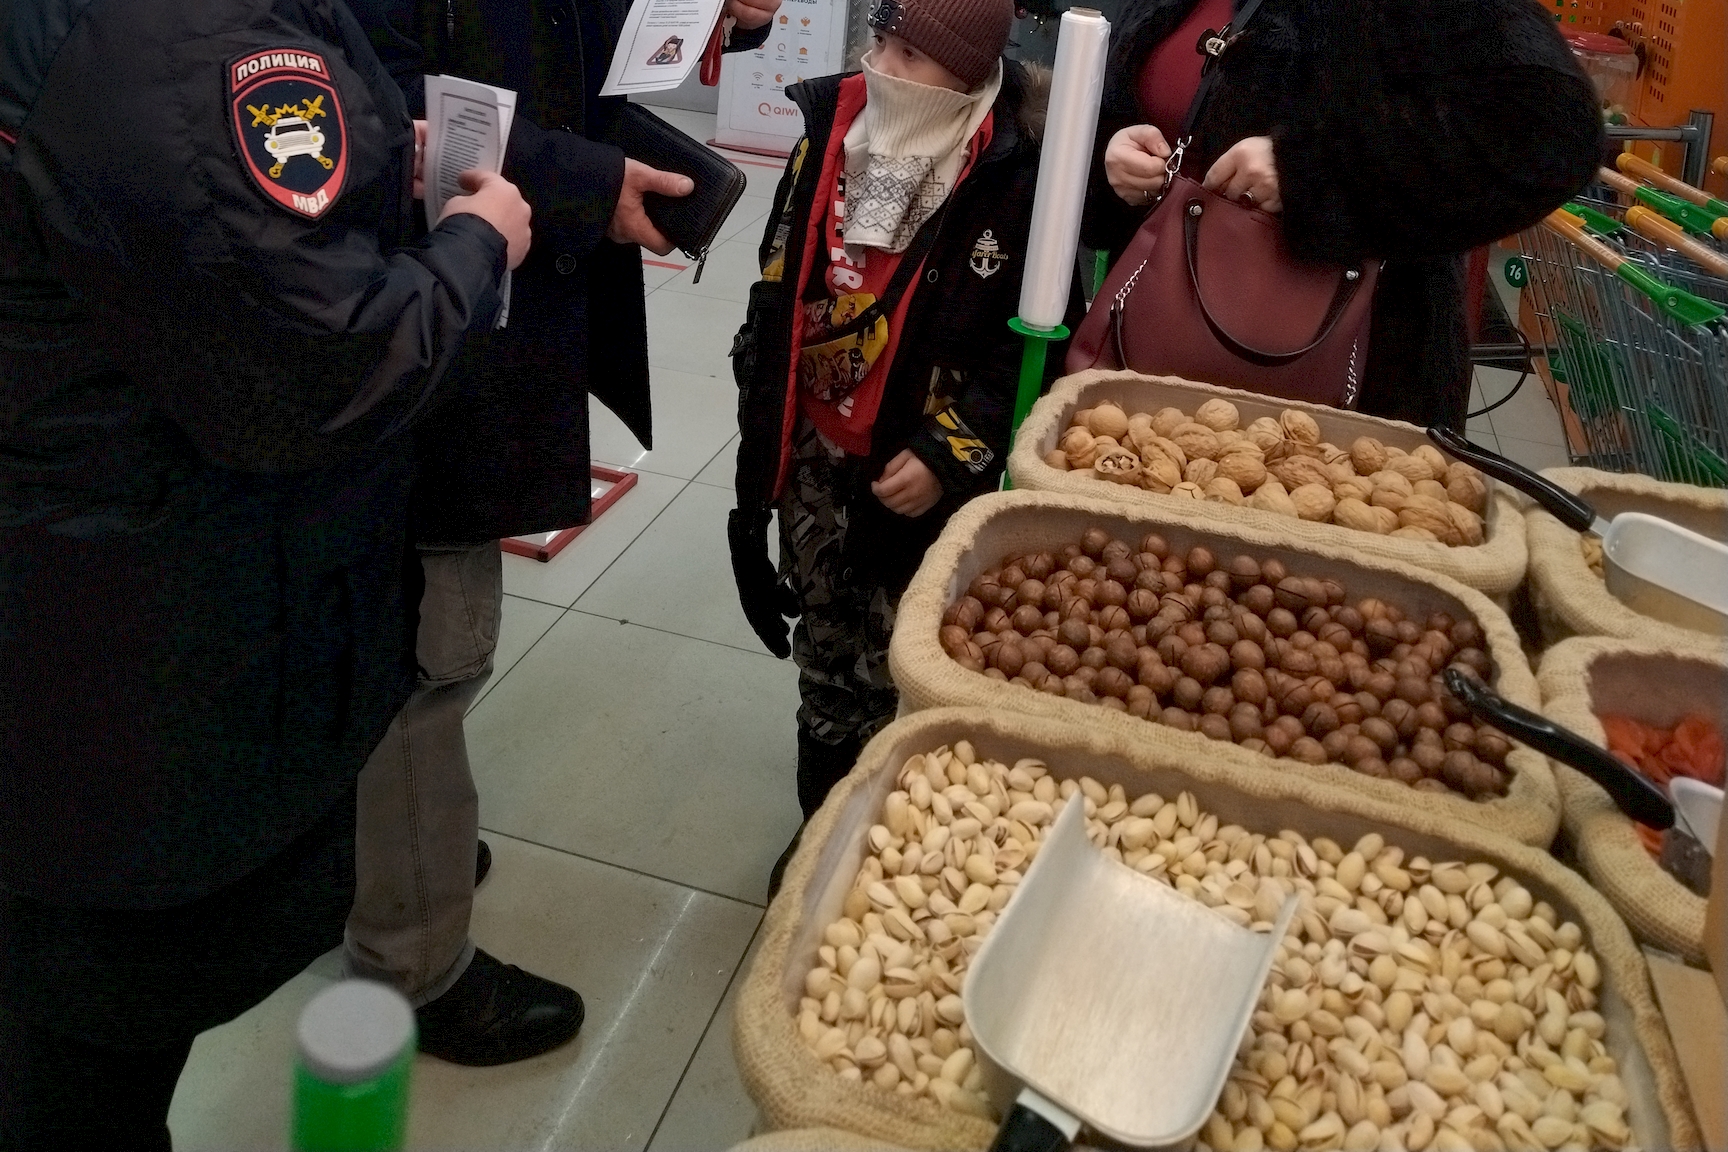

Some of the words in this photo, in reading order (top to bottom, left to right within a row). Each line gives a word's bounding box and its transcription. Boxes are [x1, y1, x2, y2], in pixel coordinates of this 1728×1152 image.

[237, 53, 322, 82] ПОЛИЦИЯ
[773, 106, 799, 118] QIWI
[292, 188, 330, 215] МВД
